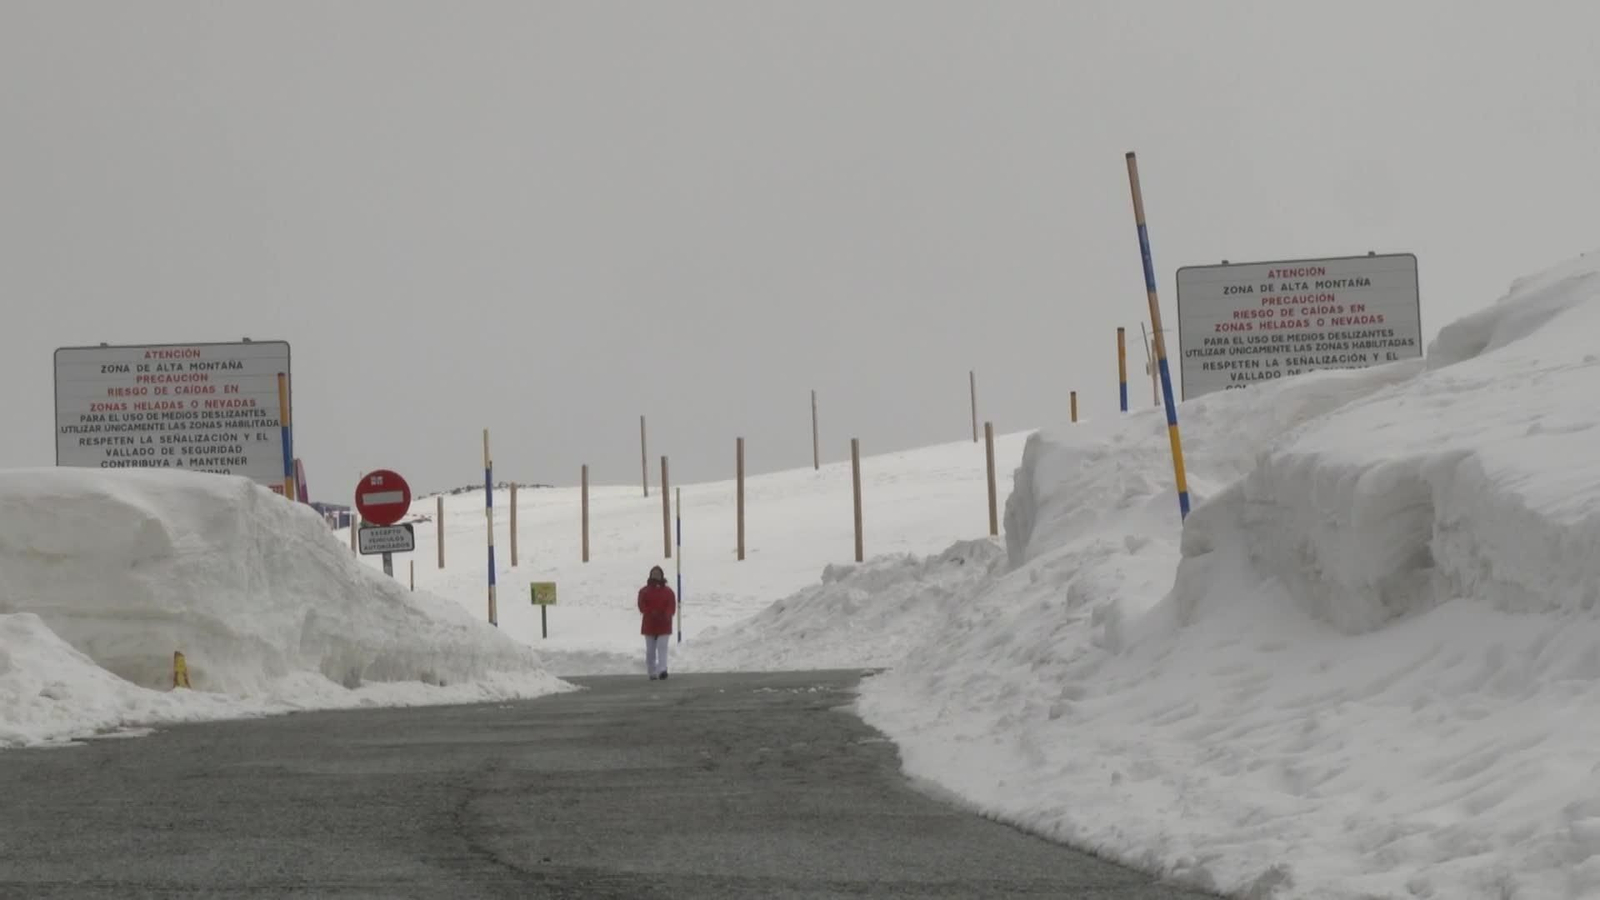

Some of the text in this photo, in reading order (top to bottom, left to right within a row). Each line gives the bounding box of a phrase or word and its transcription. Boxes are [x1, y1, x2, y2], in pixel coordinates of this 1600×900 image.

[1268, 267, 1326, 279] ATENCIÓN
[1223, 278, 1371, 295] ZONA DE ALTA MONTAÑA
[1262, 293, 1335, 306] PRECAUCIÓN
[1233, 304, 1365, 319] RIESGO DE CAÍDAS EN
[1215, 315, 1384, 332] ZONAS HELADAS O NEVADAS
[1204, 329, 1394, 346] PARA EL USO DE MEDIOS DESLIZANTES
[144, 349, 201, 359] ATENCIÓN
[1186, 338, 1414, 358] UTILIZAR ÚNICAMENTE LAS ZONAS HABILITADAS
[101, 360, 243, 373] ZONA DE ALTA MONTAÑA
[1203, 352, 1398, 370] RESPETEN LA SEÑALIZACIÓN Y EL
[136, 372, 208, 384] PRECAUCIÓN
[1231, 371, 1281, 381] VALLADO
[108, 384, 238, 397] RIESGO DE CAÍDAS EN
[90, 399, 256, 412] ZONAS HELADAS O NEVADAS
[123, 413, 144, 421] USO
[162, 412, 199, 420] MEDIOS
[202, 409, 266, 418] DESLIZANTES
[61, 425, 101, 434] UTILIZAR
[104, 422, 166, 432] ÚNICAMENTE
[168, 422, 186, 430] LAS
[189, 421, 223, 429] ZONAS
[79, 436, 134, 446] RESPETEN
[140, 435, 153, 443] LA
[160, 432, 238, 443] SEÑALIZACIÓN
[243, 433, 250, 441] Y
[106, 445, 242, 456] VALLADO DE SEGURIDAD
[101, 457, 247, 468] CONTRIBUYA A MANTENER
